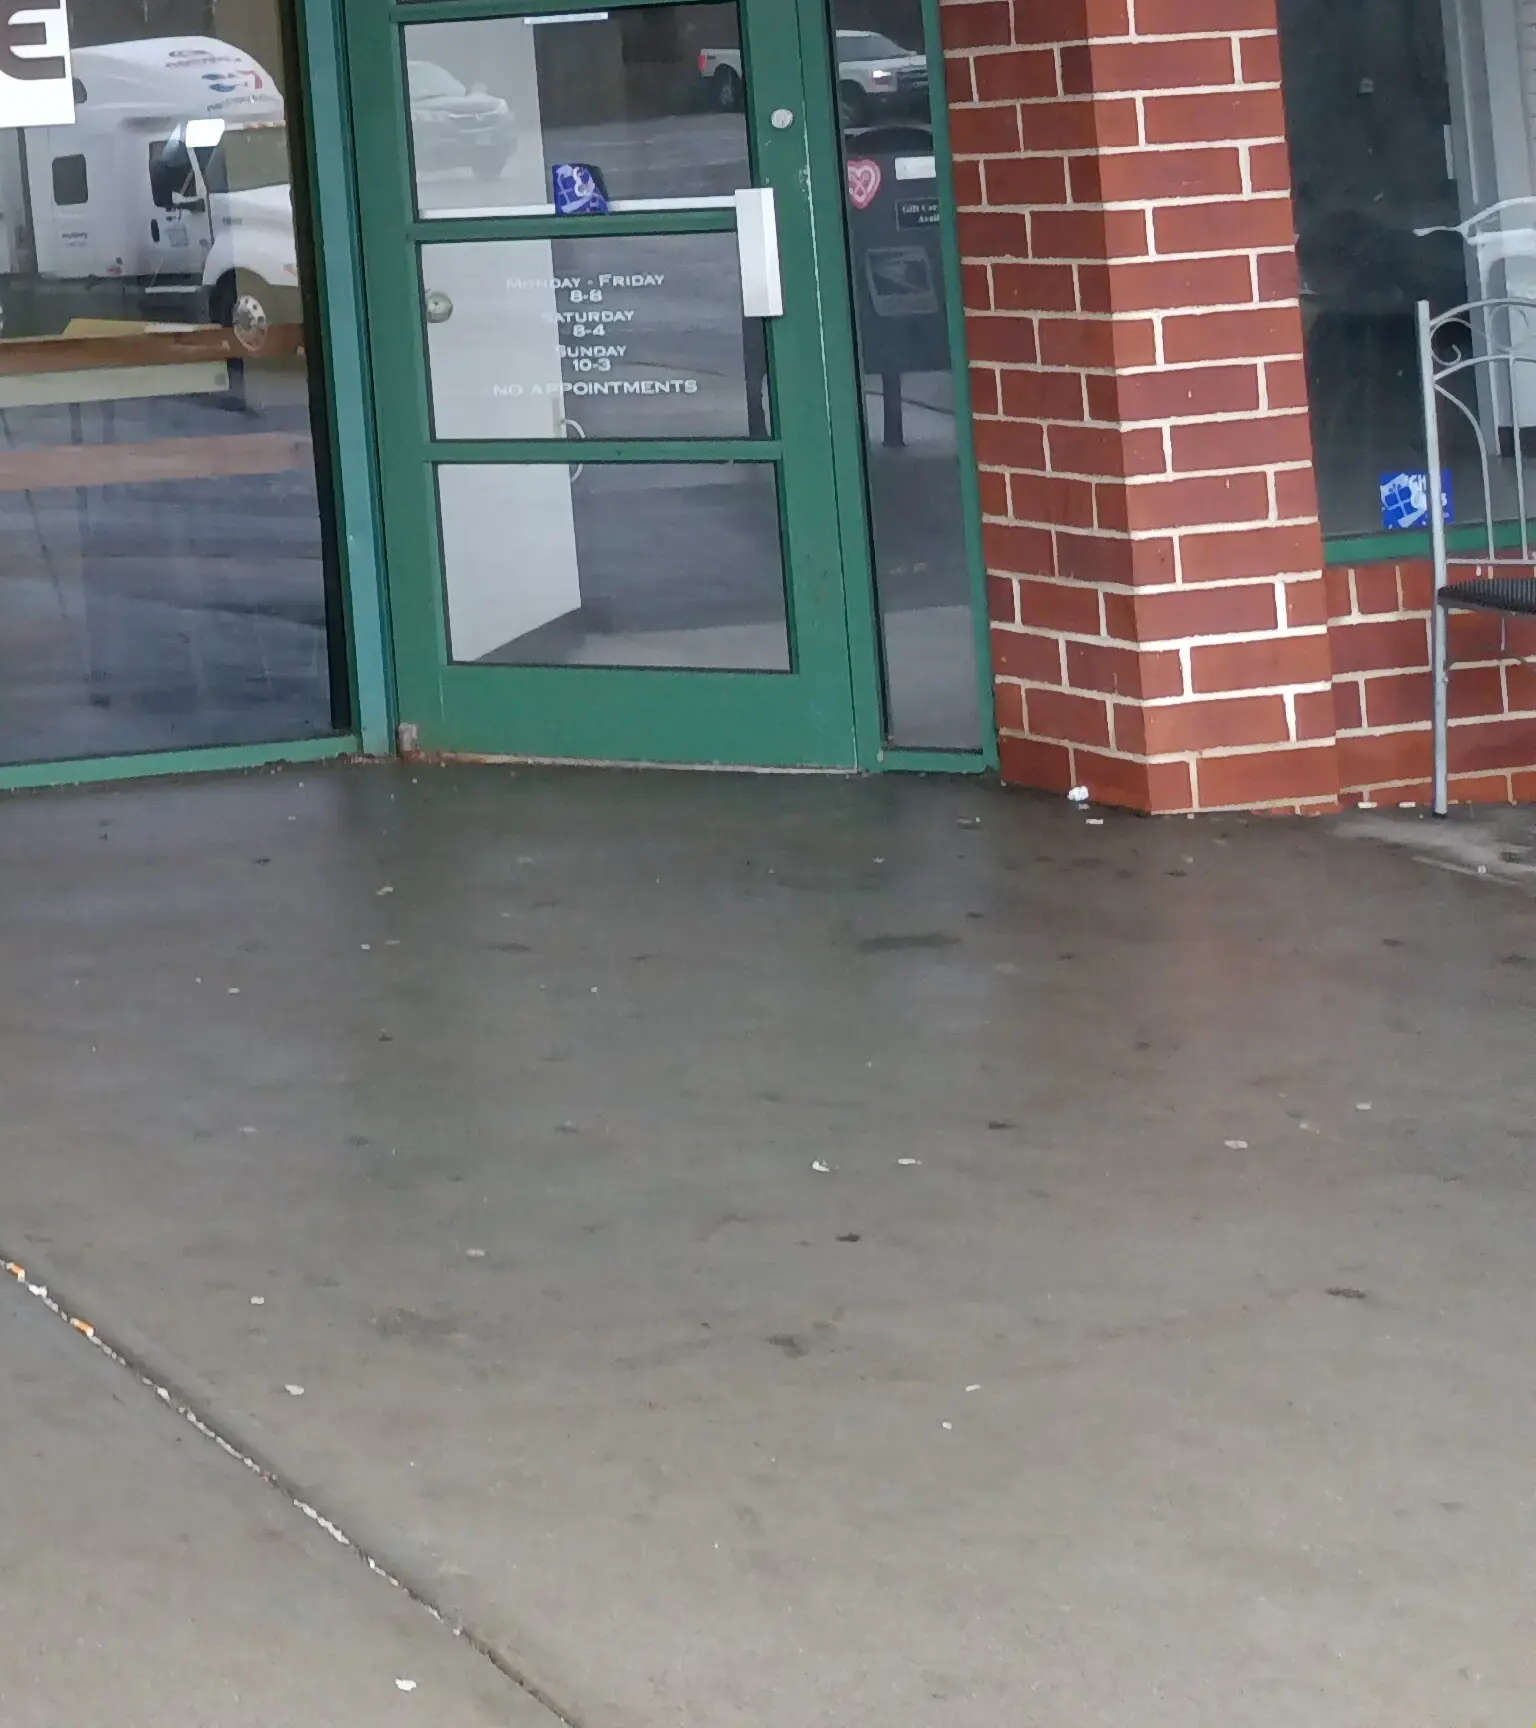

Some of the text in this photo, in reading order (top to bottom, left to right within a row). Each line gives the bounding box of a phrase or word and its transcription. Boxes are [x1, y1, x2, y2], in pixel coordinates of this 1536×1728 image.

[598, 274, 665, 287] FRIDAY
[572, 324, 606, 337] 8-4
[555, 345, 627, 358] SUNDAY
[572, 358, 611, 372] 10-3
[493, 379, 698, 396] NO APPOINTMENTS
